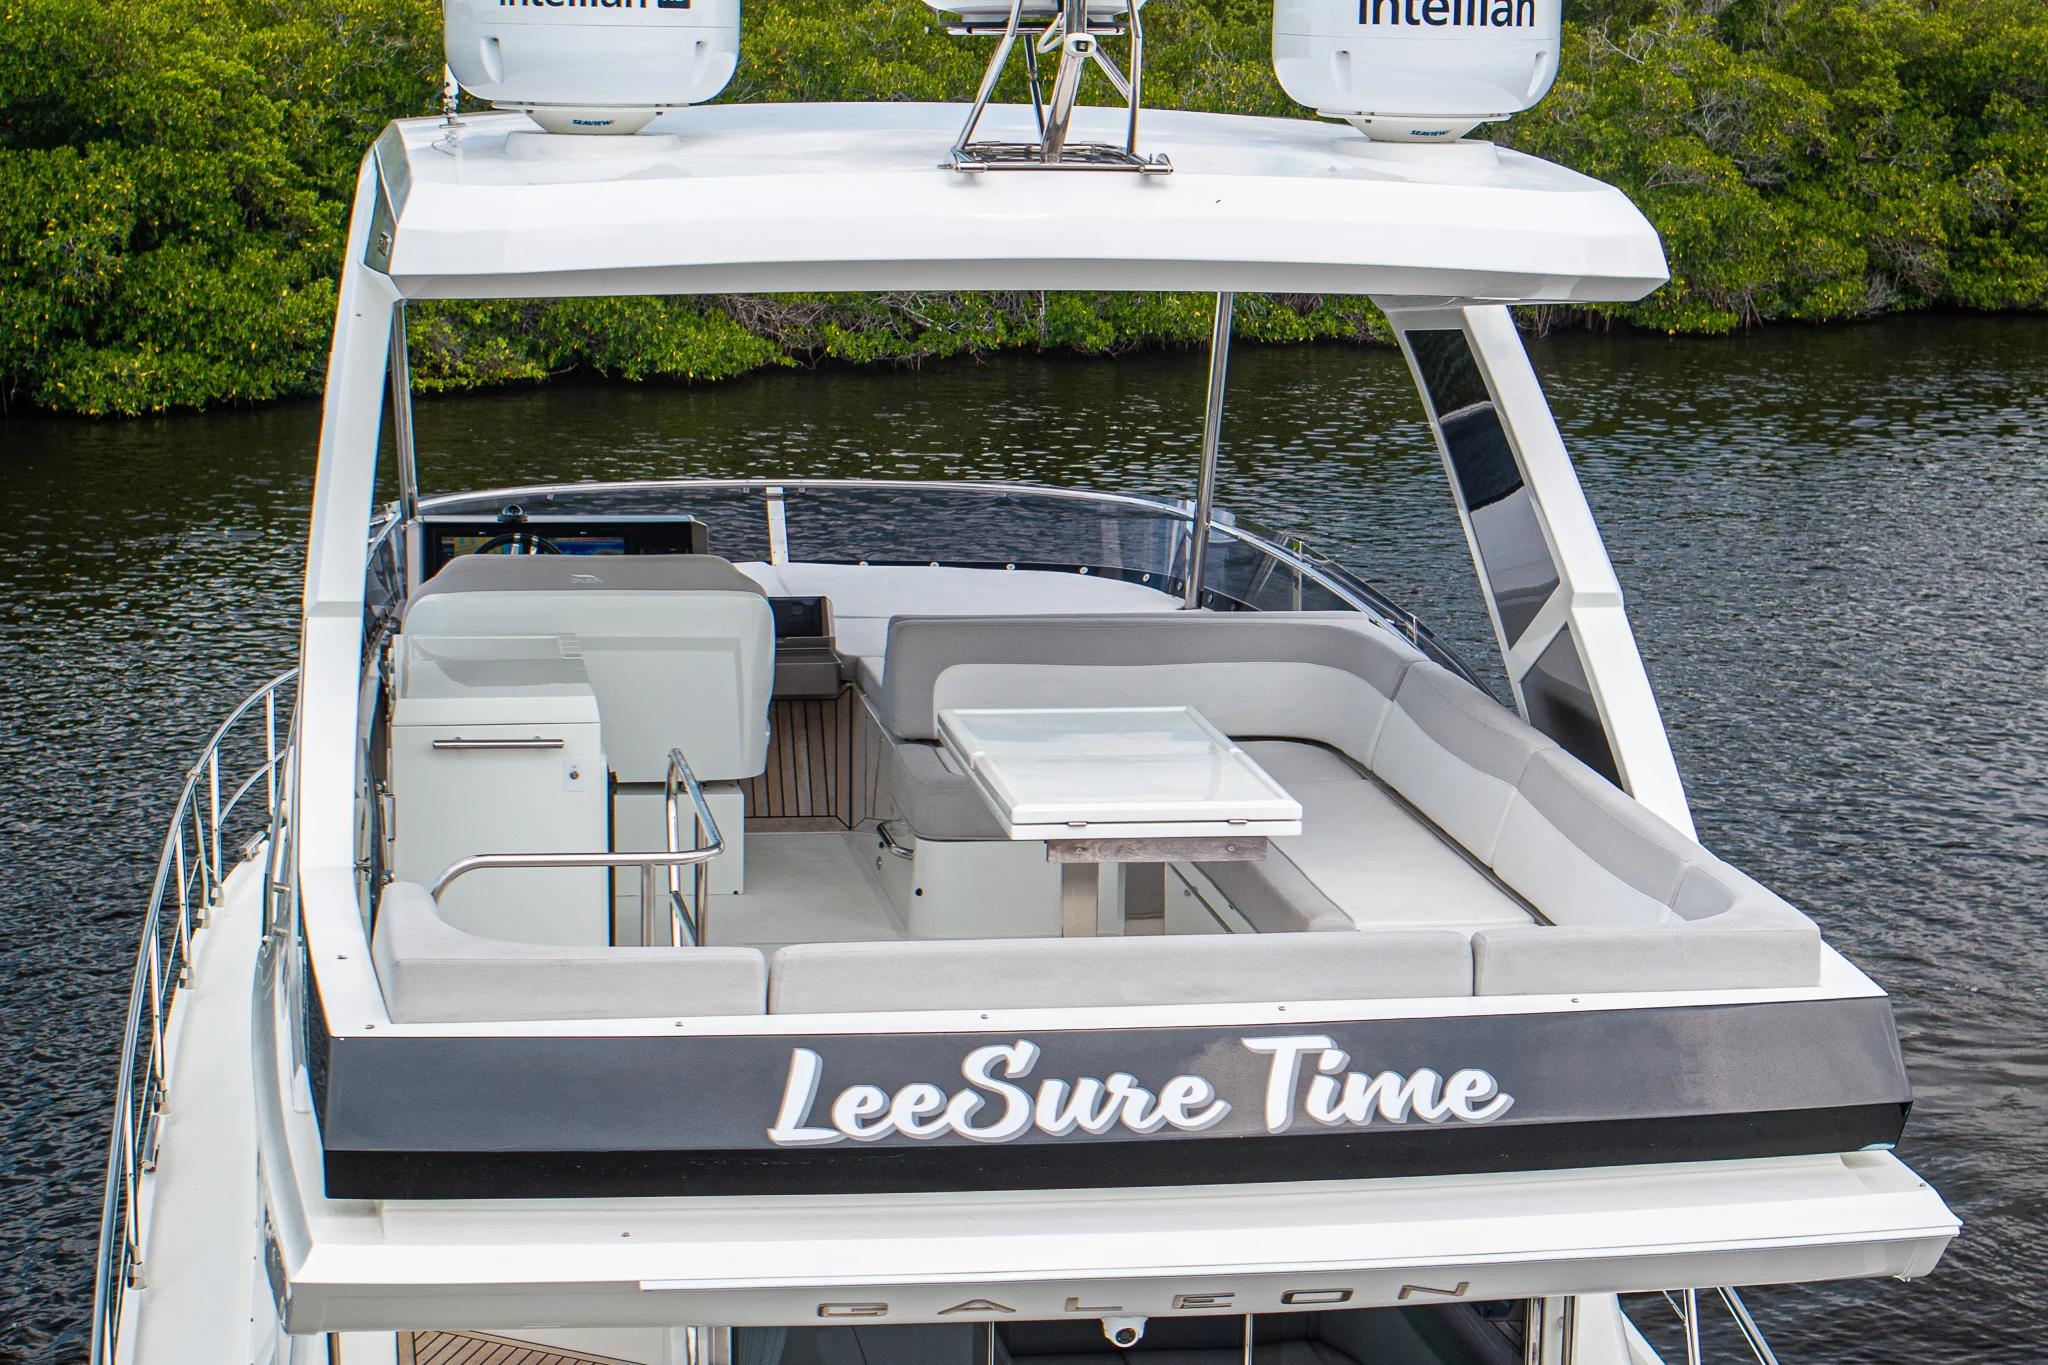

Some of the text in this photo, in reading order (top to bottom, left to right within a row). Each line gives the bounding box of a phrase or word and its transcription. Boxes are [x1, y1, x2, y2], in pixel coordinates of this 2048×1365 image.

[767, 1033, 1515, 1144] LeeSure Time
[816, 1281, 1470, 1318] GALEON
